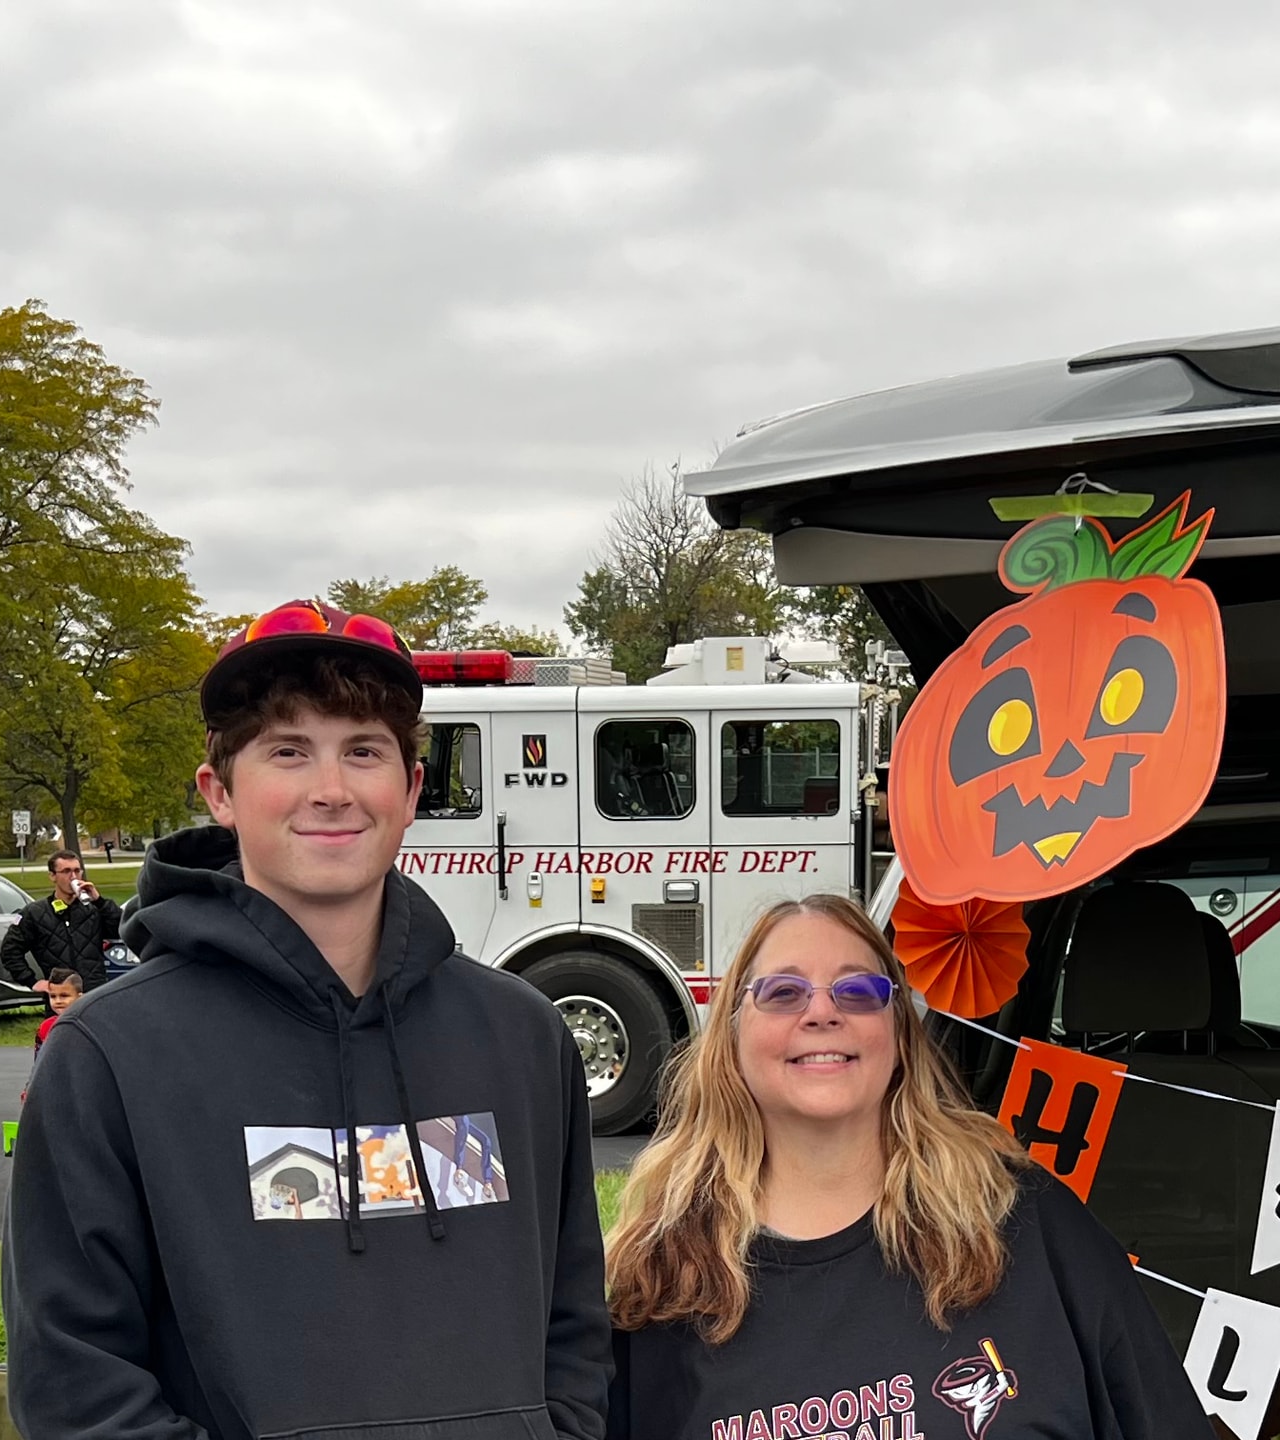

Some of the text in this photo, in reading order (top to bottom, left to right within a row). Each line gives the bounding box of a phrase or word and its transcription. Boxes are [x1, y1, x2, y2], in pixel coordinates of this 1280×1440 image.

[504, 772, 568, 788] FWD
[15, 822, 29, 833] 30
[397, 850, 819, 875] INTHROP HARBOR FIRE DEPT.
